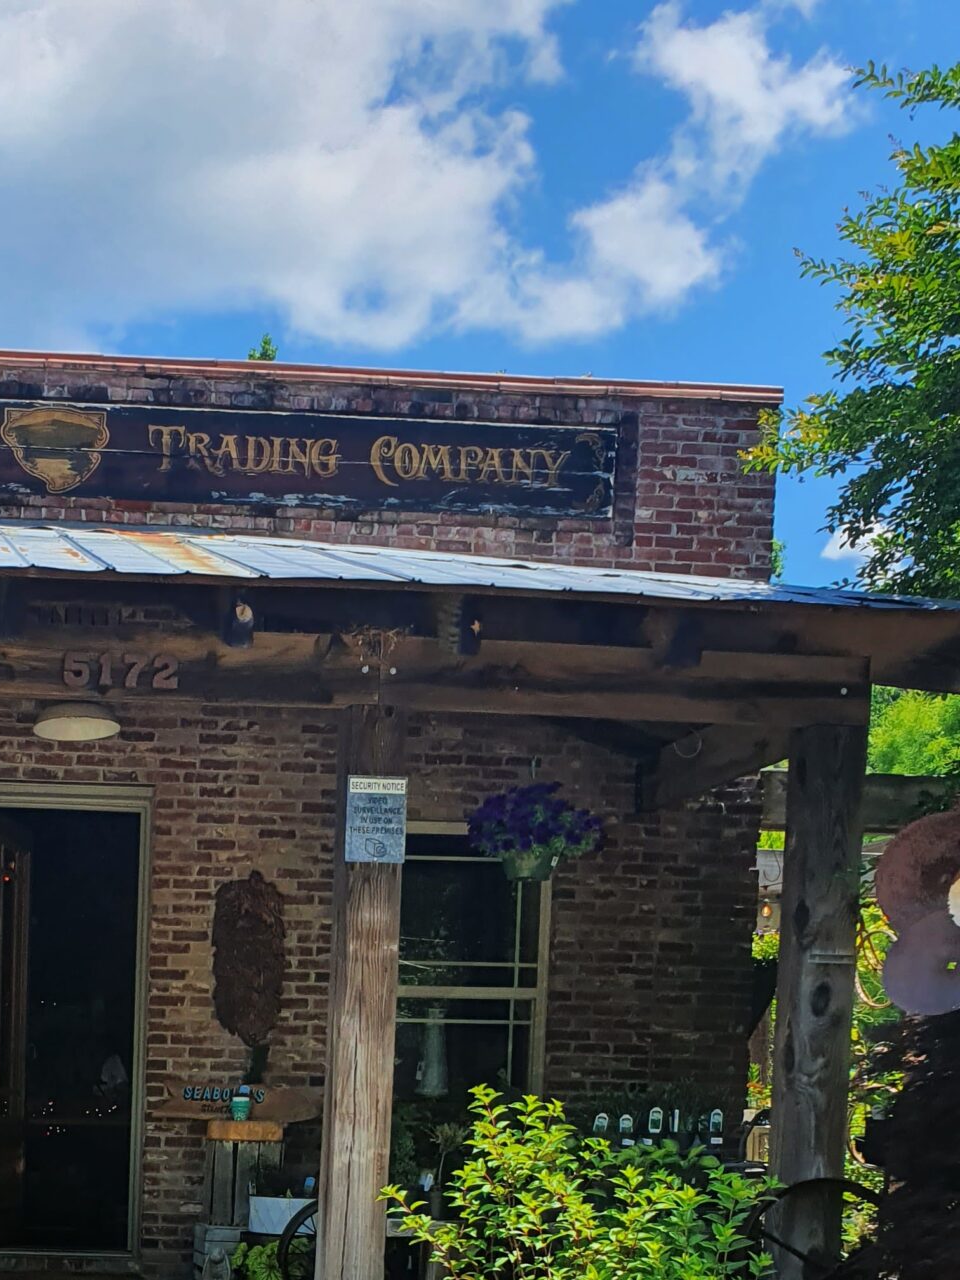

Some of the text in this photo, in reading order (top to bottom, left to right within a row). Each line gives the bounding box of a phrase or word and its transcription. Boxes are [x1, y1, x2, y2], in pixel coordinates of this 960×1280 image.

[148, 424, 342, 478] TRADING
[369, 434, 572, 489] COMPANY
[62, 649, 179, 689] 5172
[351, 781, 405, 791] SECURITY NOTICE
[353, 806, 402, 816] SURVEILLANCE
[383, 817, 393, 825] ON
[350, 826, 404, 836] THESE PREMISES
[184, 1085, 265, 1104] SEABO'S
